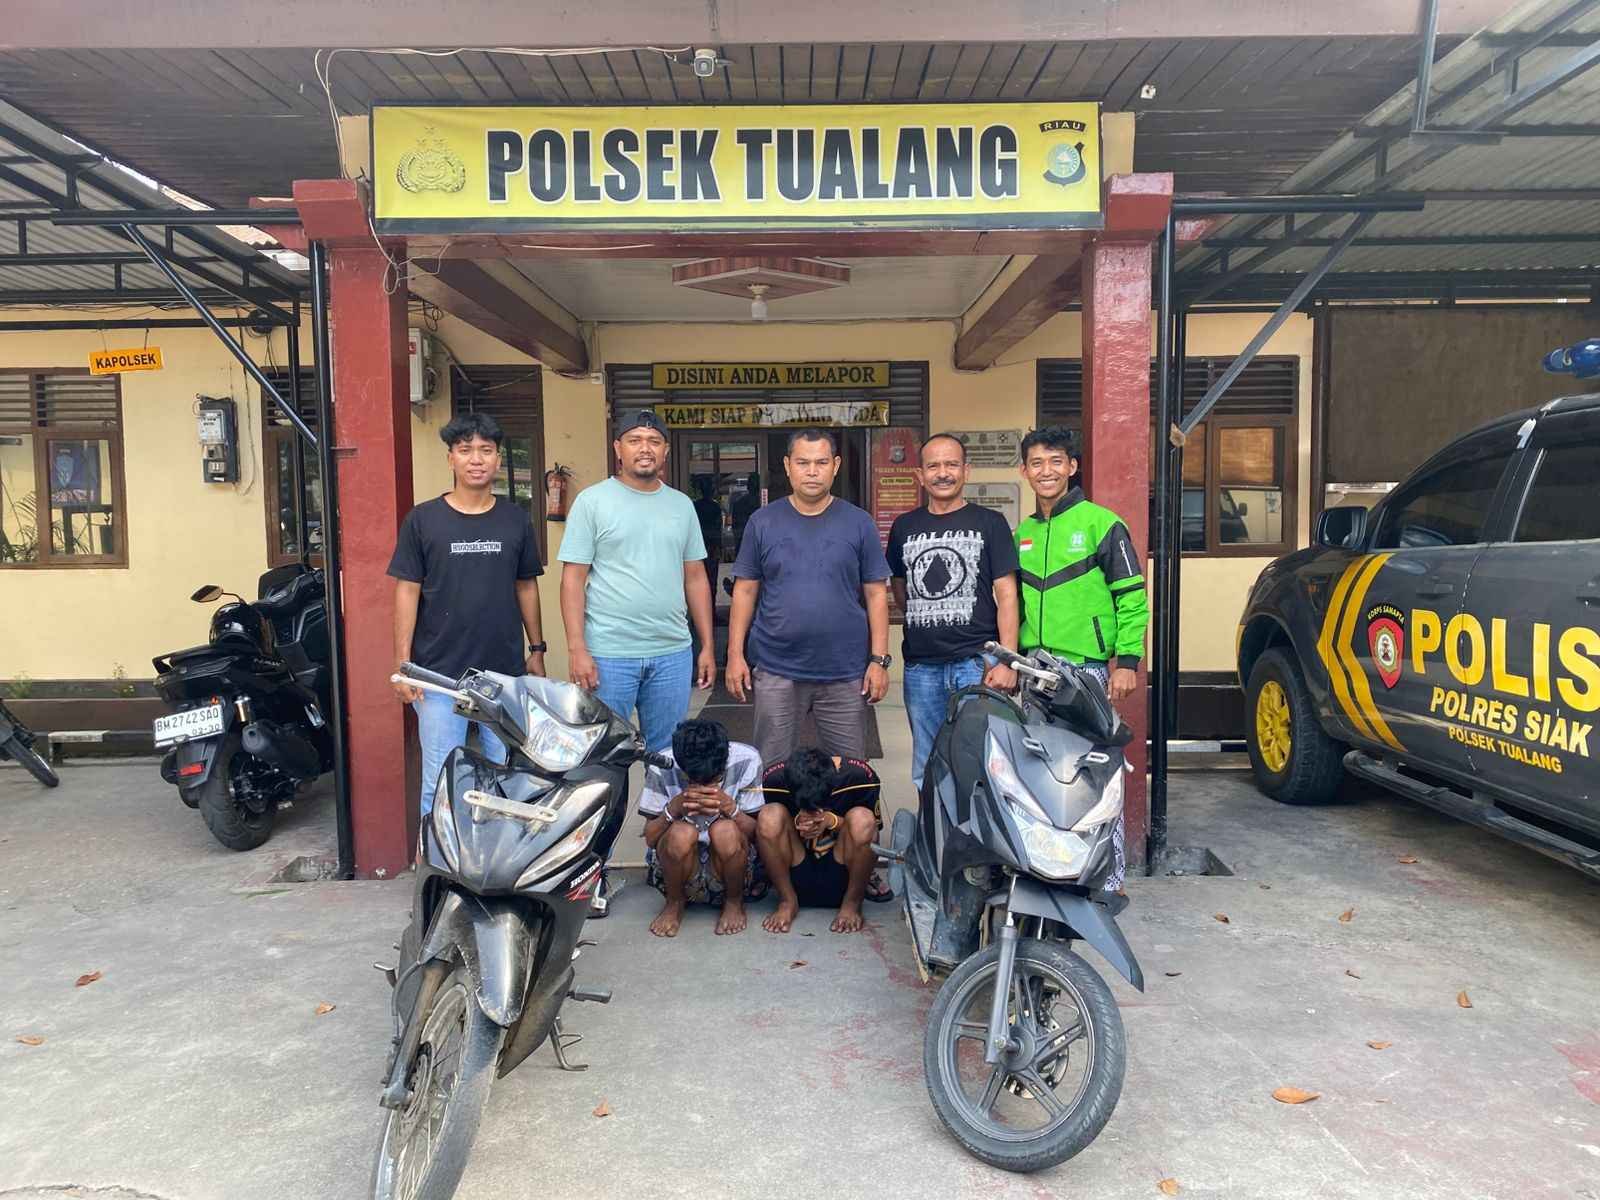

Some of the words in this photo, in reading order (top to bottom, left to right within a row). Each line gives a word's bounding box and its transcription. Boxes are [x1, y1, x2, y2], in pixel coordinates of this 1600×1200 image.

[1043, 121, 1081, 131] RIAU
[487, 128, 721, 202] POLSEK
[736, 125, 1018, 202] TUALANG
[95, 353, 156, 369] KAPOLSEK
[666, 367, 724, 385] DISINI
[730, 367, 780, 385] ANDA
[786, 366, 876, 384] MELAPOR
[664, 407, 706, 425] KAMI
[711, 407, 747, 424] SIAP
[1411, 608, 1600, 712] POLIS
[1430, 686, 1518, 735] POLRES
[1524, 710, 1593, 757] SIAK
[1448, 726, 1497, 753] POLSEK
[1498, 740, 1563, 773] TUALANG
